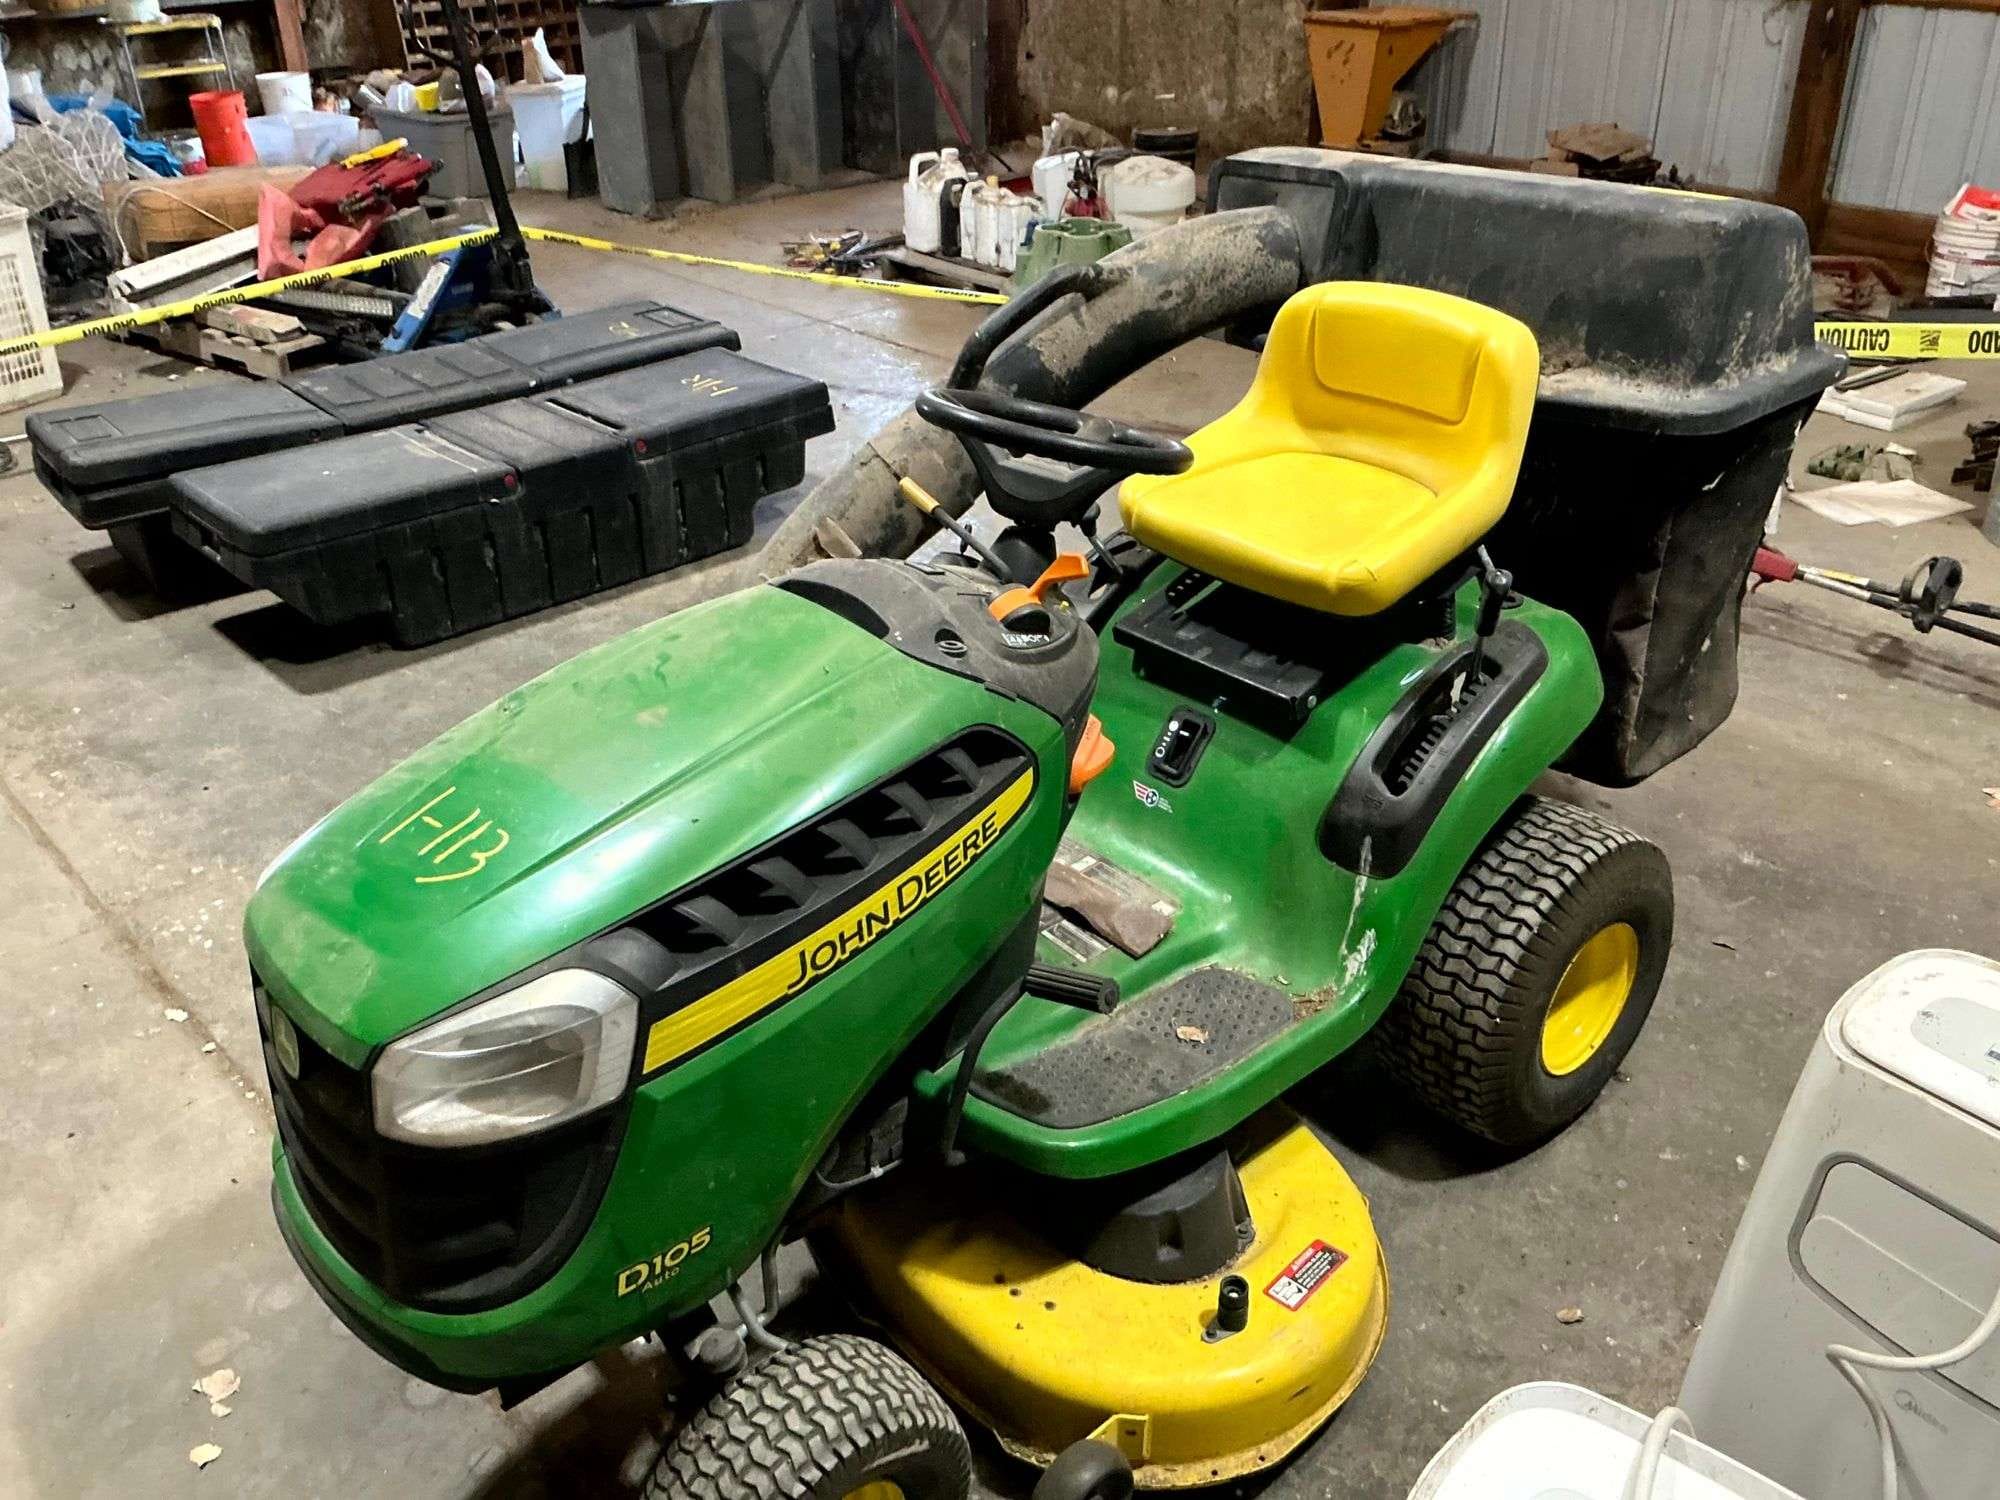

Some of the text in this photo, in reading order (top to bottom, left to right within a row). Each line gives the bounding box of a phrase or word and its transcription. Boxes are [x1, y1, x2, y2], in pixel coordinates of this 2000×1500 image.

[1819, 328, 1890, 352] CAUTION
[786, 899, 890, 992] JOHN
[896, 810, 998, 912] DEERE
[617, 1226, 711, 1297] D105
